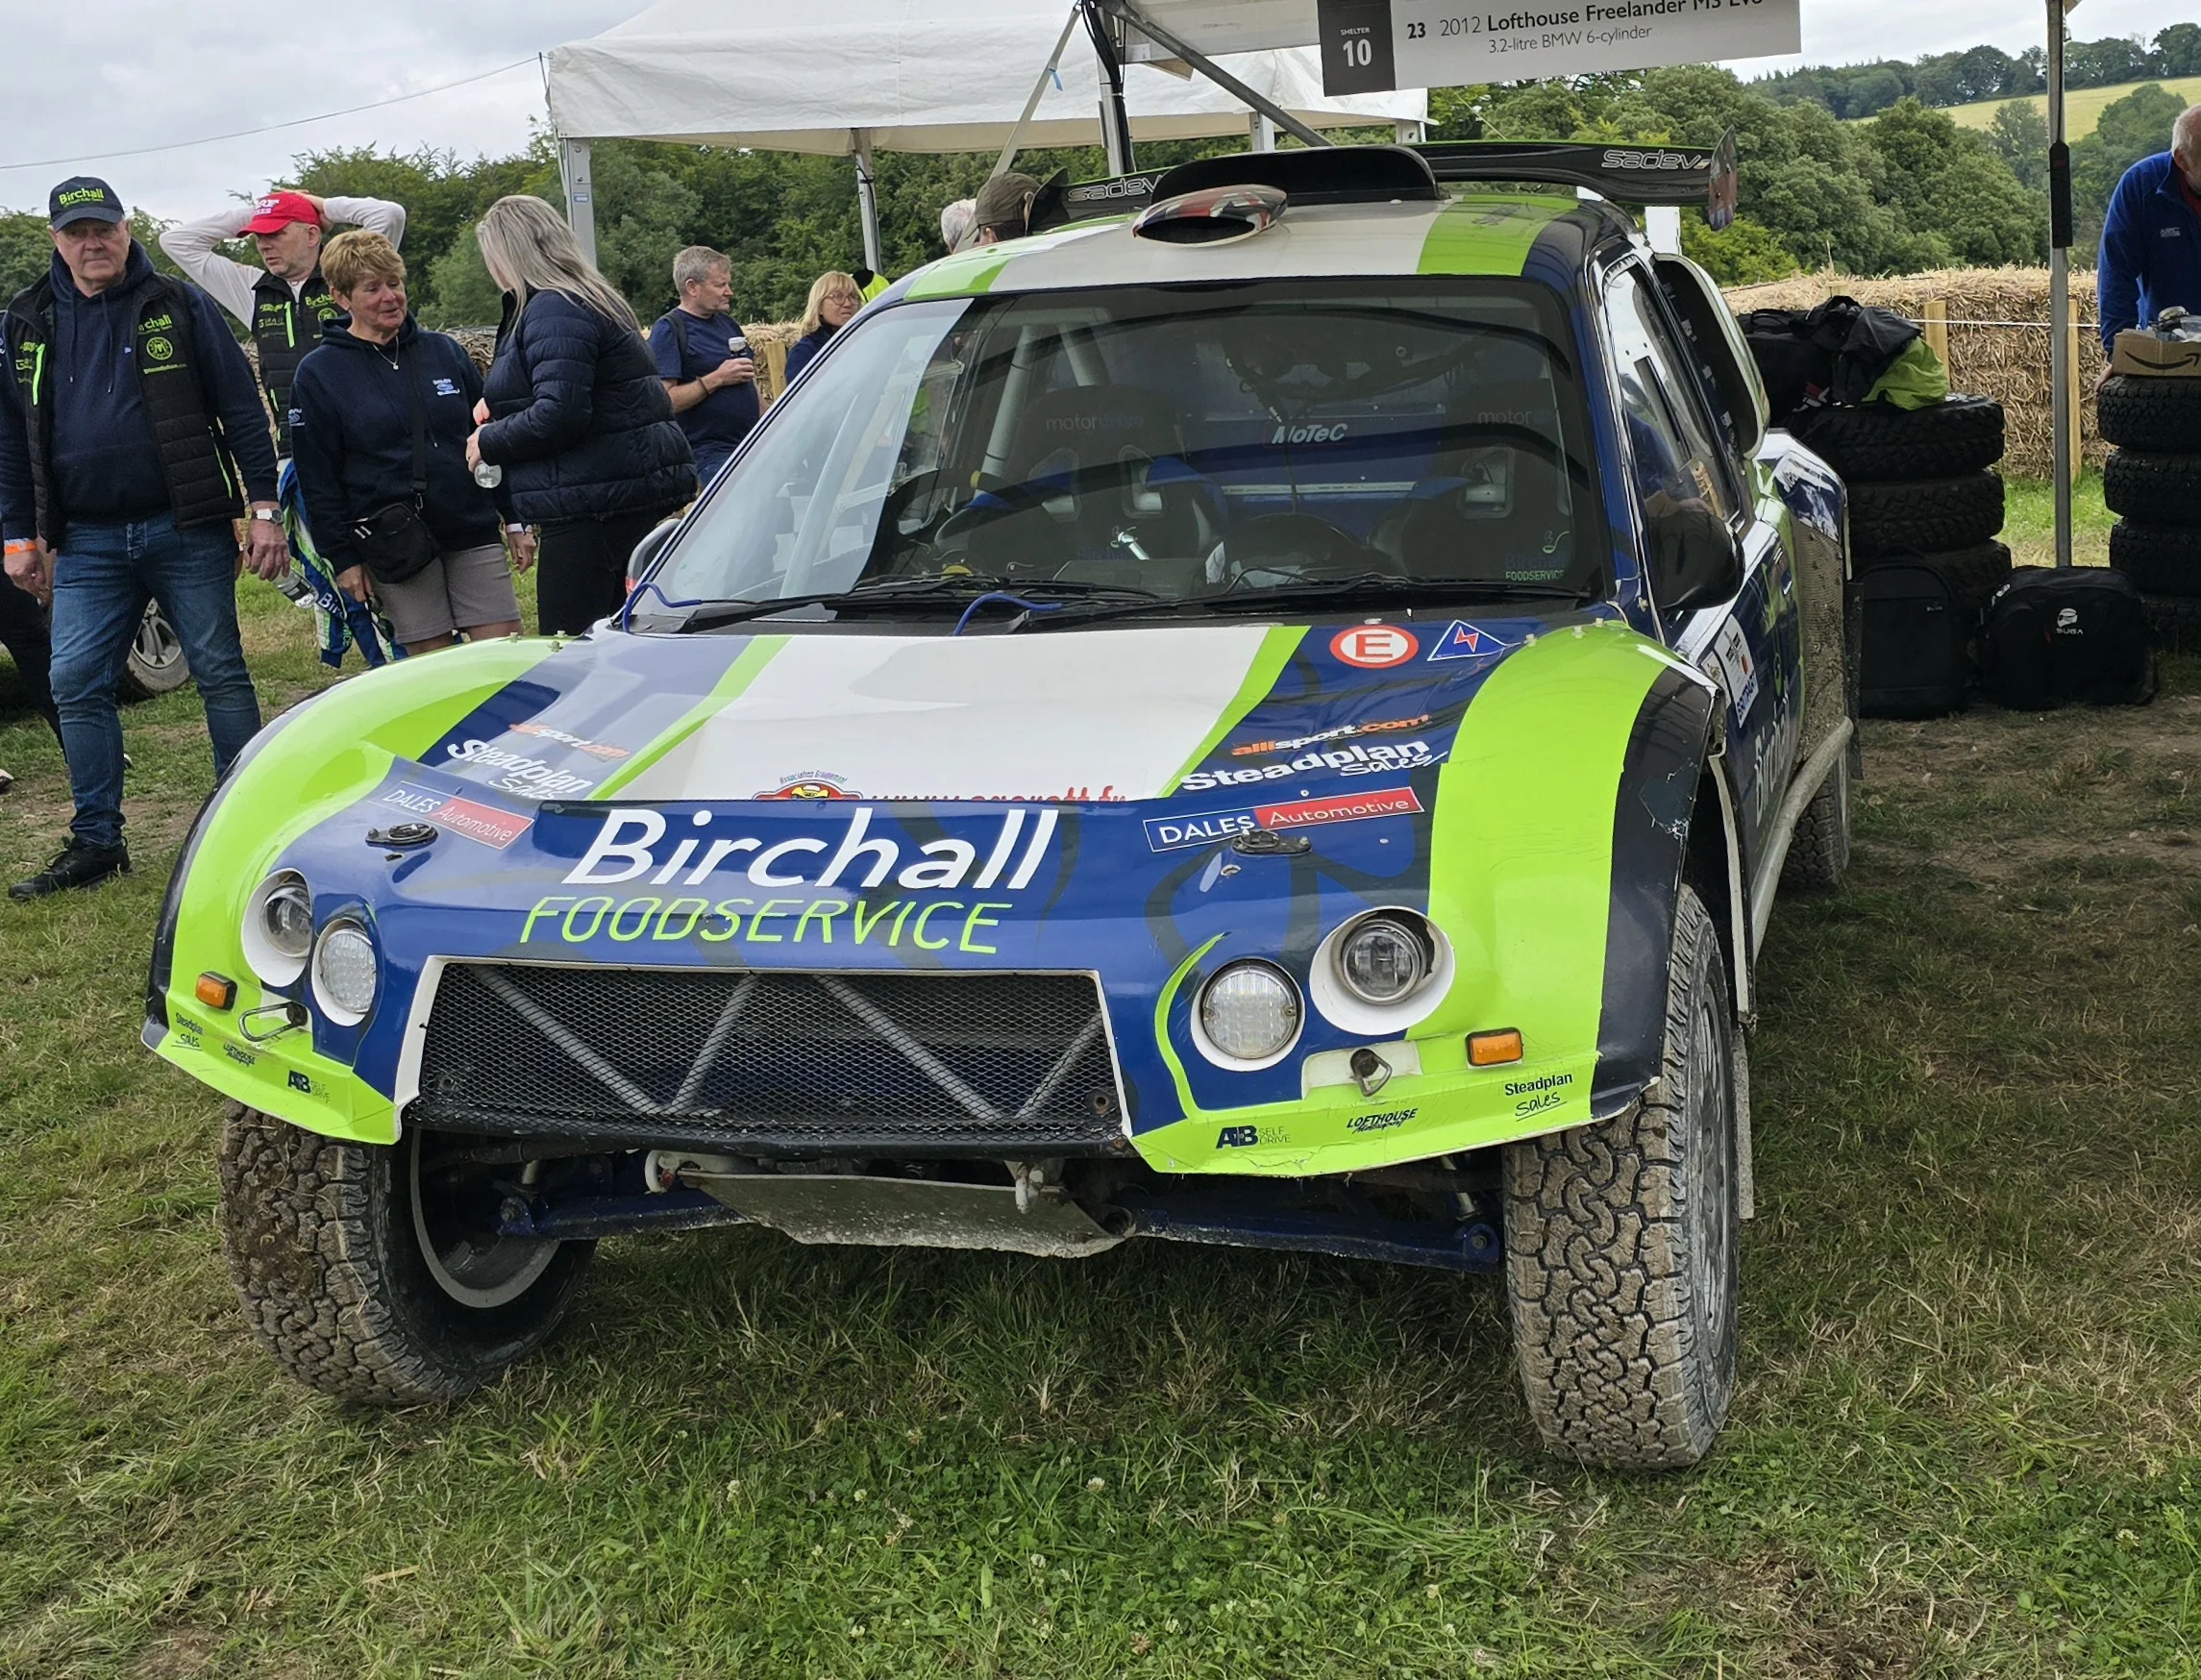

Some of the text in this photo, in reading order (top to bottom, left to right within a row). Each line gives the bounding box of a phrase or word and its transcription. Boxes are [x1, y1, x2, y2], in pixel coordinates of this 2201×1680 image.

[1407, 22, 1426, 39] 23
[1440, 16, 1482, 37] 2012
[1488, 12, 1579, 32] Lofthouse
[1586, 0, 1687, 22] Freelander
[1343, 38, 1372, 67] 10
[1489, 26, 1652, 54] 3.2-litre BMW 6-cylinder
[1601, 149, 1702, 169] sadev
[59, 187, 105, 206] Birchall
[1068, 175, 1163, 202] sadev
[1355, 633, 1393, 658] E
[447, 739, 593, 795] Steadplan
[1180, 740, 1430, 791] Steadplan
[383, 789, 513, 842] DALES Automotive
[1158, 798, 1410, 844] DALES Automotive
[561, 807, 1060, 890] Birchall
[519, 896, 1013, 954] FOODSERVICE
[1504, 1074, 1572, 1097] Steadplan
[1258, 1126, 1284, 1137] SELF
[1346, 1107, 1419, 1128] LOFTHOUSE
[1259, 1134, 1291, 1146] DRIVE
